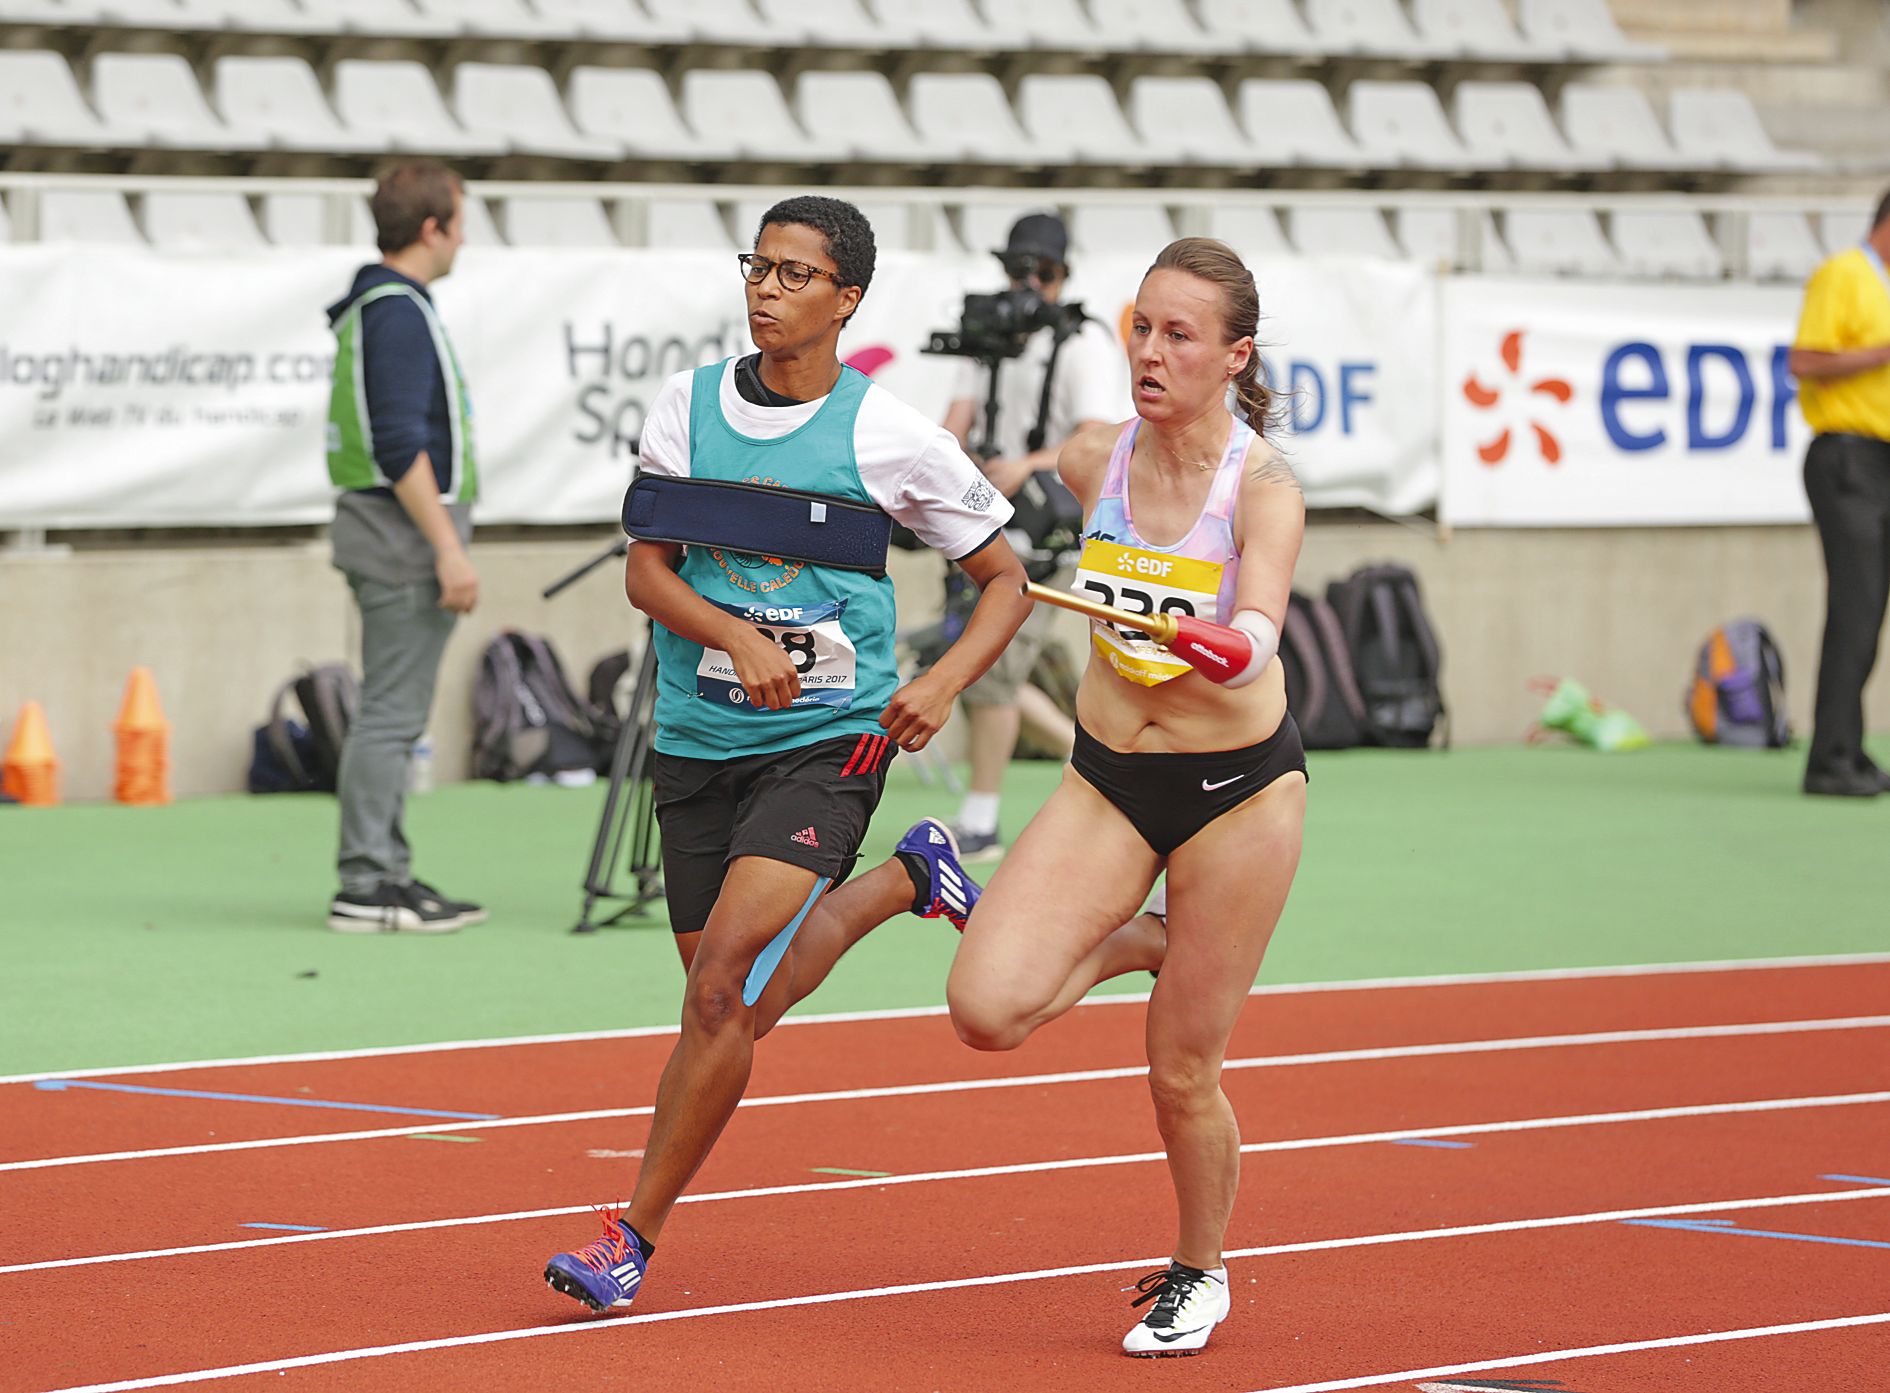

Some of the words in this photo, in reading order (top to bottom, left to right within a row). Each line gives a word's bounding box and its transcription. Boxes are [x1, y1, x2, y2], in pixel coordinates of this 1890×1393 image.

[1262, 361, 1376, 435] DF
[757, 628, 817, 674] 8
[825, 675, 848, 684] 2017
[790, 834, 820, 848] adidas
